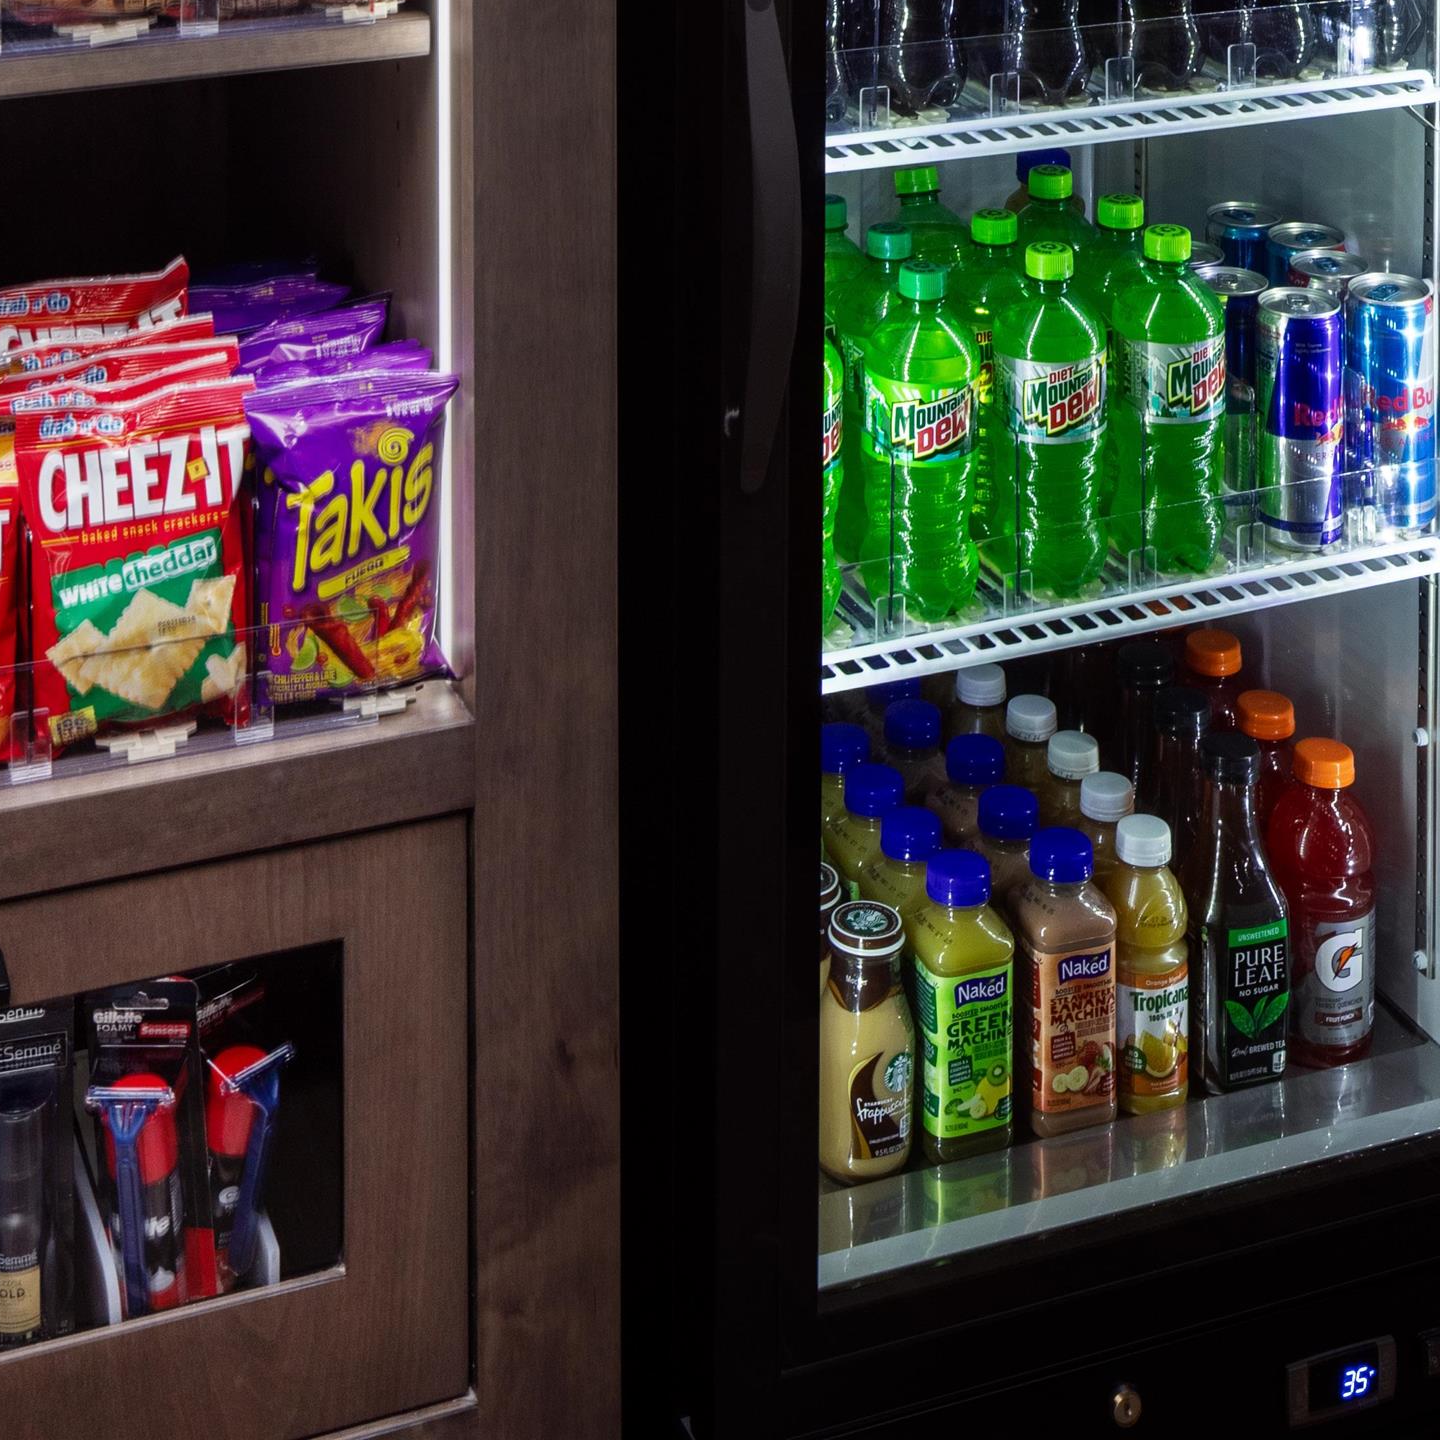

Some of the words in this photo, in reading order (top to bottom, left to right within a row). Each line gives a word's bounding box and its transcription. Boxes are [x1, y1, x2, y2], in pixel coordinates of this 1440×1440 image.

[1048, 367, 1075, 385] DIET
[287, 427, 434, 594] Takis
[82, 528, 117, 546] baked
[122, 521, 158, 539] snack
[163, 512, 220, 534] crackers
[344, 559, 384, 585] FUEGO
[1238, 926, 1280, 942] UNSWEETENED
[1061, 955, 1109, 980] Naked
[1234, 944, 1285, 970] PURE
[957, 978, 1005, 1004] Naked
[1129, 984, 1189, 1014] Tropicana
[1239, 989, 1252, 998] NO
[1253, 984, 1279, 996] SUGAR
[93, 1009, 143, 1026] Gillette
[96, 1023, 134, 1033] FOAMY
[947, 1011, 1012, 1038] GREEN
